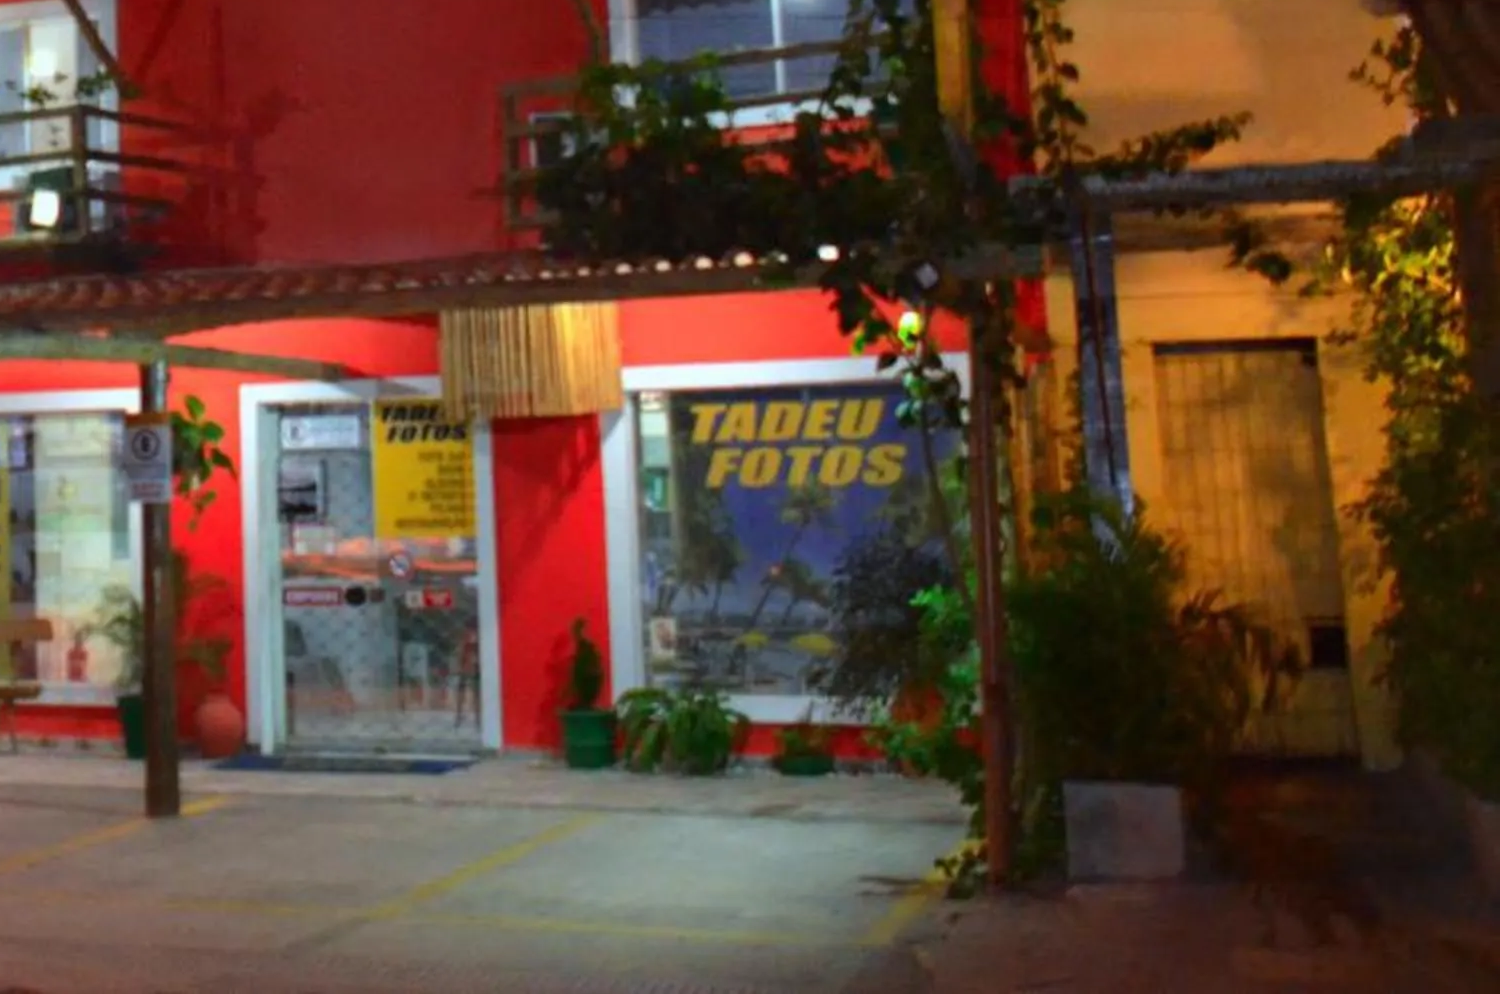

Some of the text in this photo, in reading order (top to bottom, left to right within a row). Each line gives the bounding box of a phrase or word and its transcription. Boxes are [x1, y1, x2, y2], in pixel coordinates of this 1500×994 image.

[381, 405, 443, 423] TADE
[690, 398, 886, 444] TADEU
[387, 423, 468, 442] FOTOS
[706, 442, 909, 489] FOTOS
